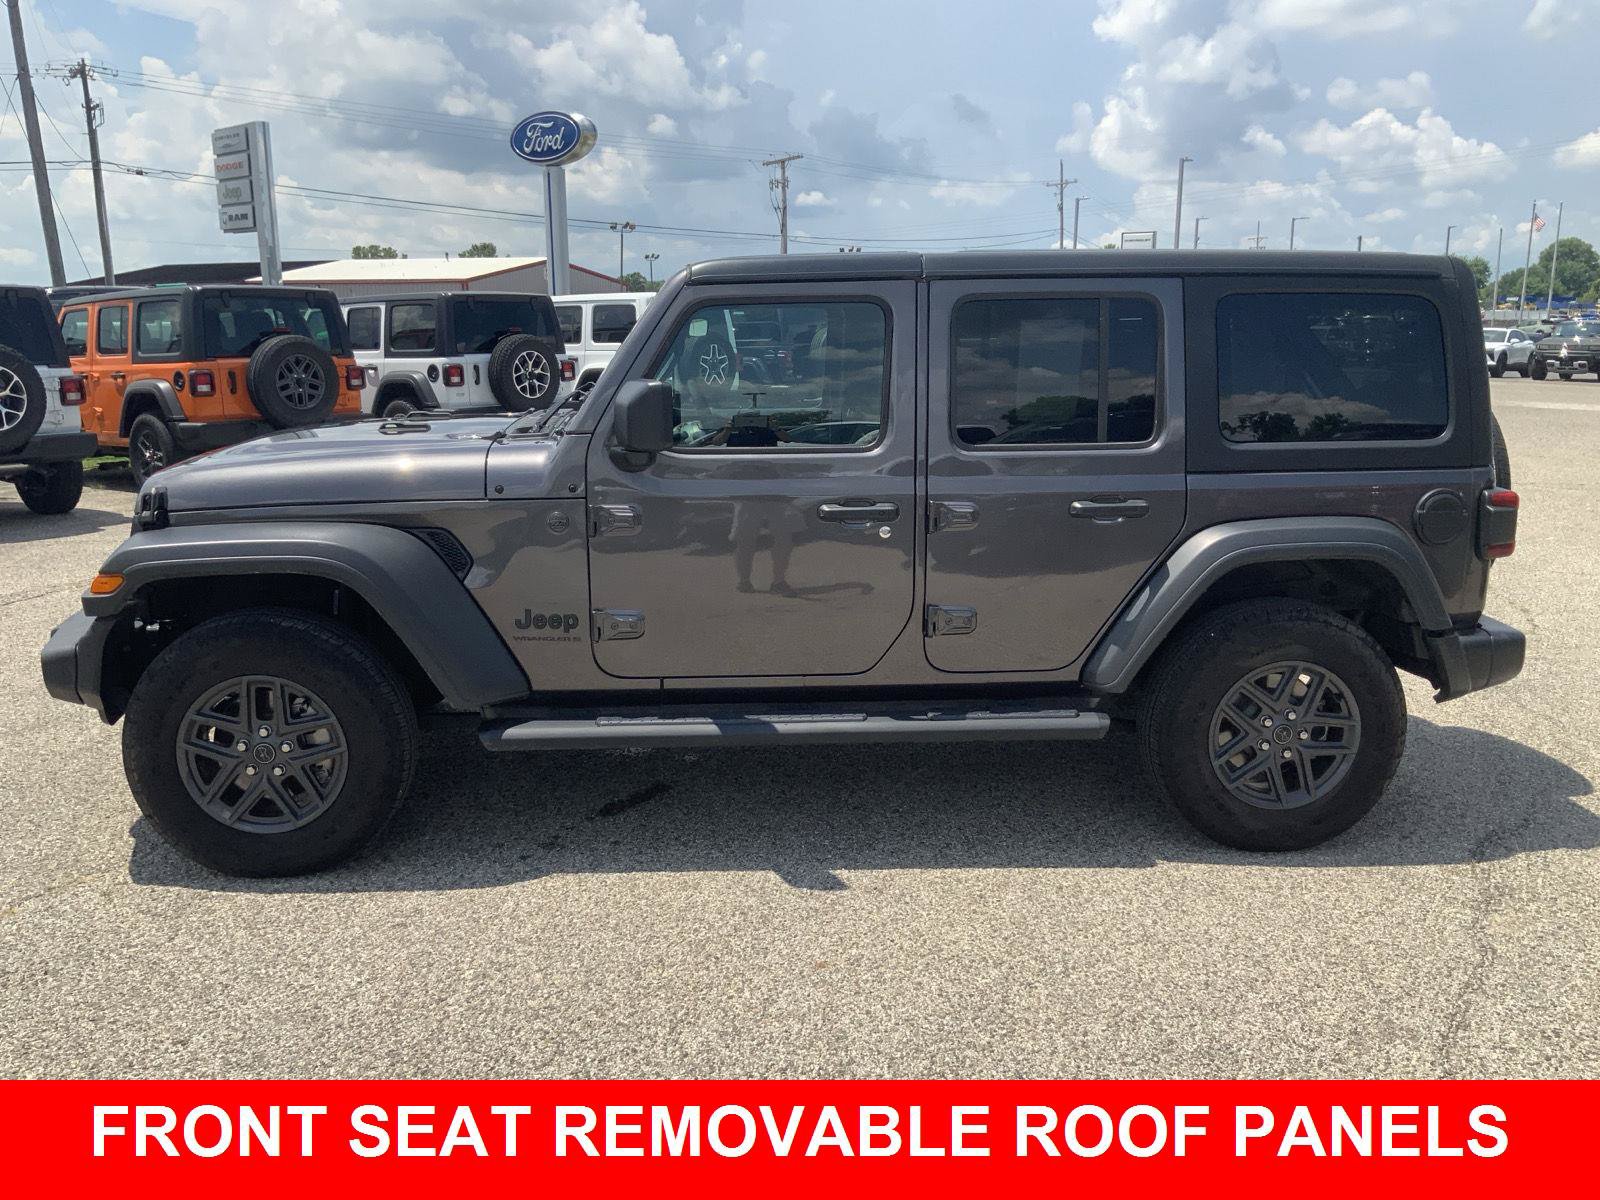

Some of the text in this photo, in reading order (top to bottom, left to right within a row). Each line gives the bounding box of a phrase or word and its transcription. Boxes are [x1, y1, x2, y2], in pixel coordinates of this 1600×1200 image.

[523, 121, 565, 153] Ford
[216, 161, 244, 173] DODGE
[222, 185, 242, 201] Jeep
[228, 213, 249, 222] RAM
[514, 608, 579, 634] Jeep
